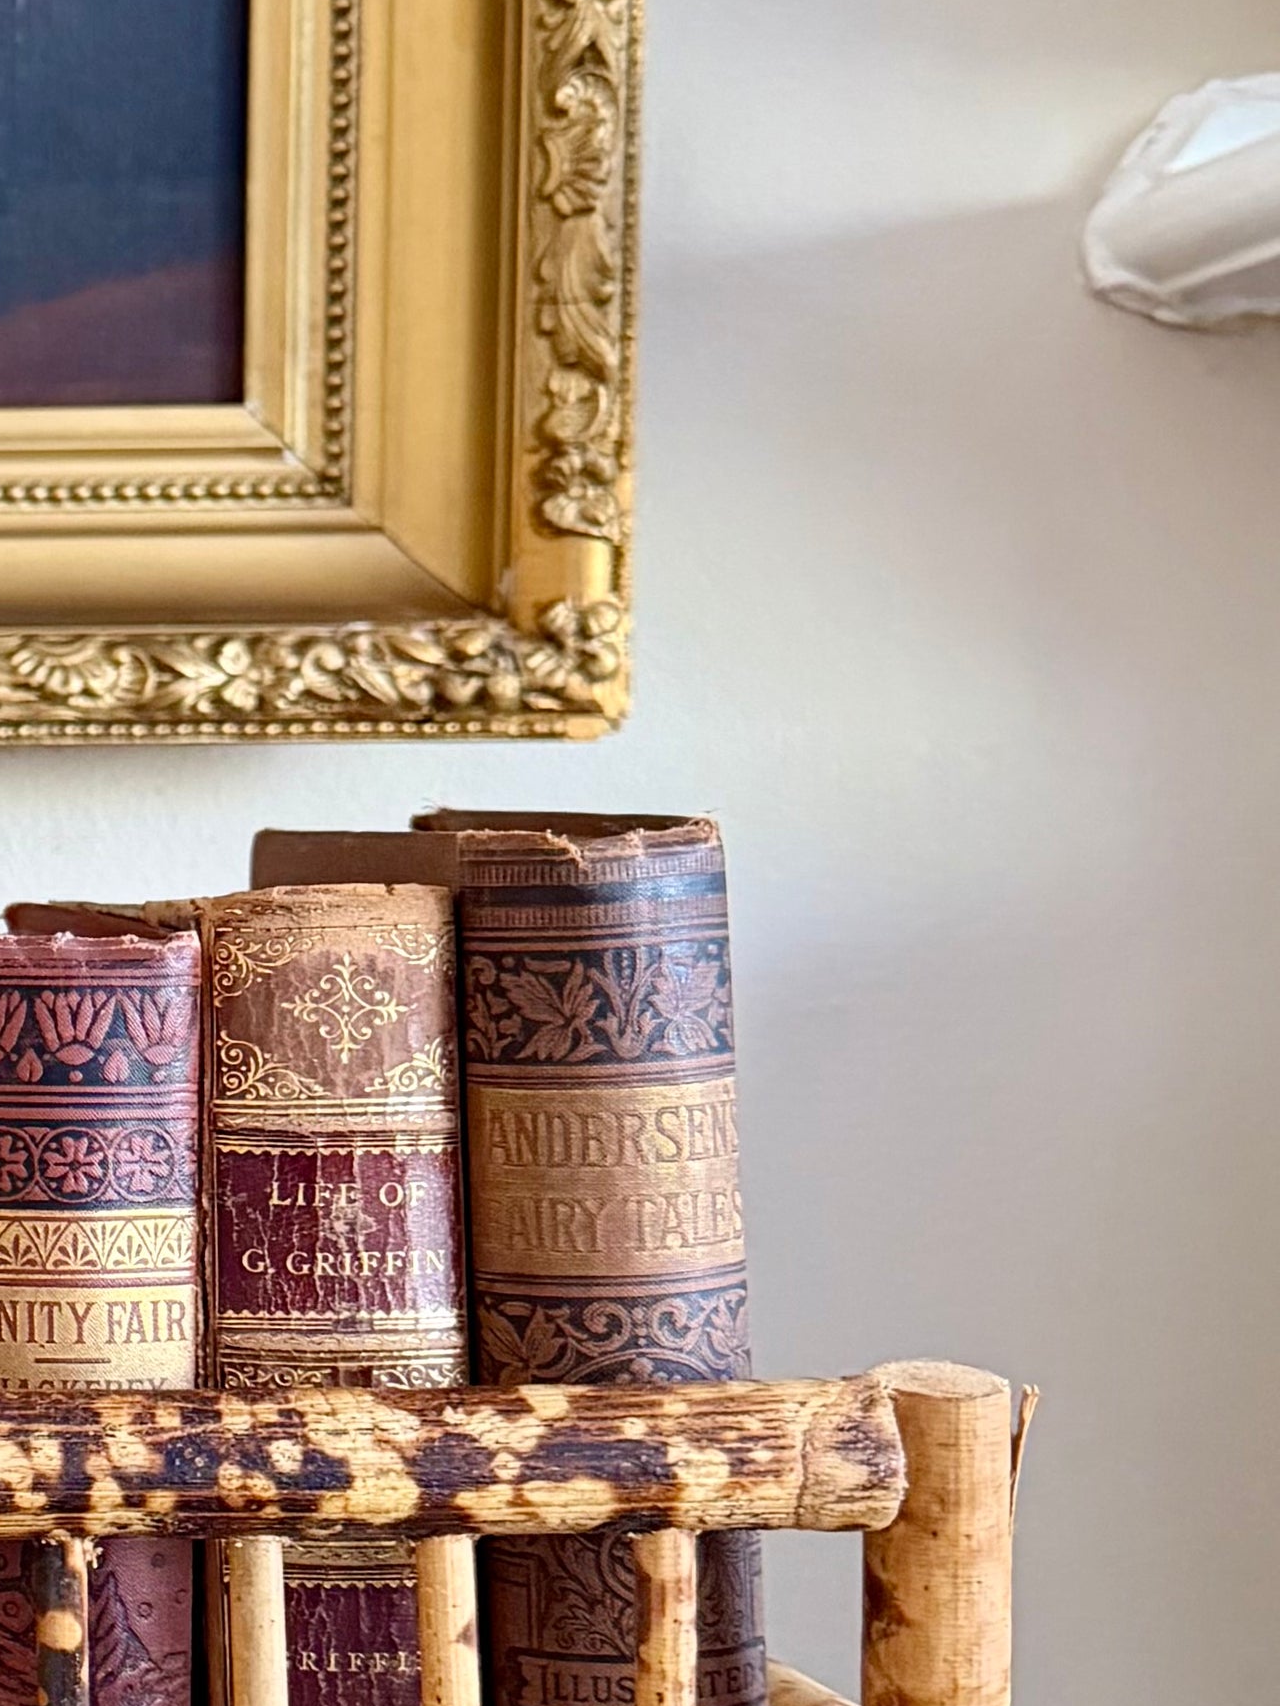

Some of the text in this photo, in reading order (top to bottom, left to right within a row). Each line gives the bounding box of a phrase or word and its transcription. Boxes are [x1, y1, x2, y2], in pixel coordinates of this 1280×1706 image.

[269, 1181, 429, 1208] LIFE OF
[286, 1248, 446, 1277] GRIFFIN
[105, 1298, 189, 1344] FAIR
[287, 1649, 423, 1674] RIFFI
[539, 1662, 756, 1706] ILLUSTED
